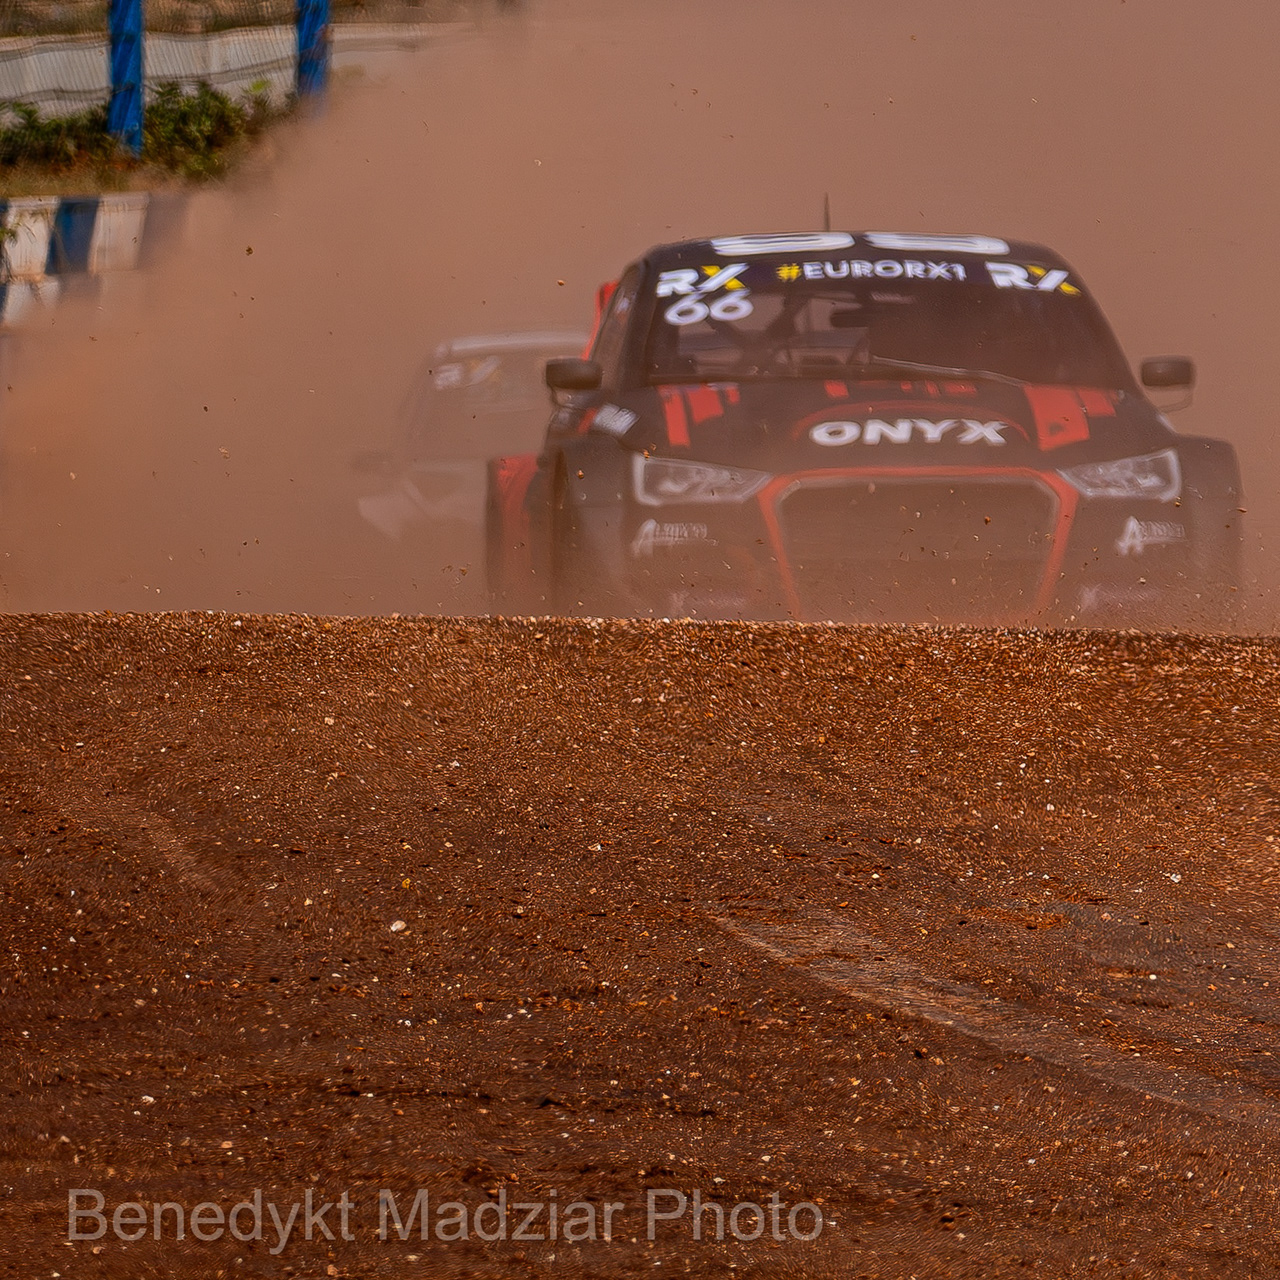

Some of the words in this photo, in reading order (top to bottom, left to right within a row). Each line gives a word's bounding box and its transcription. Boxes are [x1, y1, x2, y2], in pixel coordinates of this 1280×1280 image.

[656, 262, 750, 298] RX
[775, 260, 967, 282] #EURORX1
[985, 261, 1082, 296] RX
[663, 288, 755, 326] 66
[808, 419, 1009, 447] ONYX
